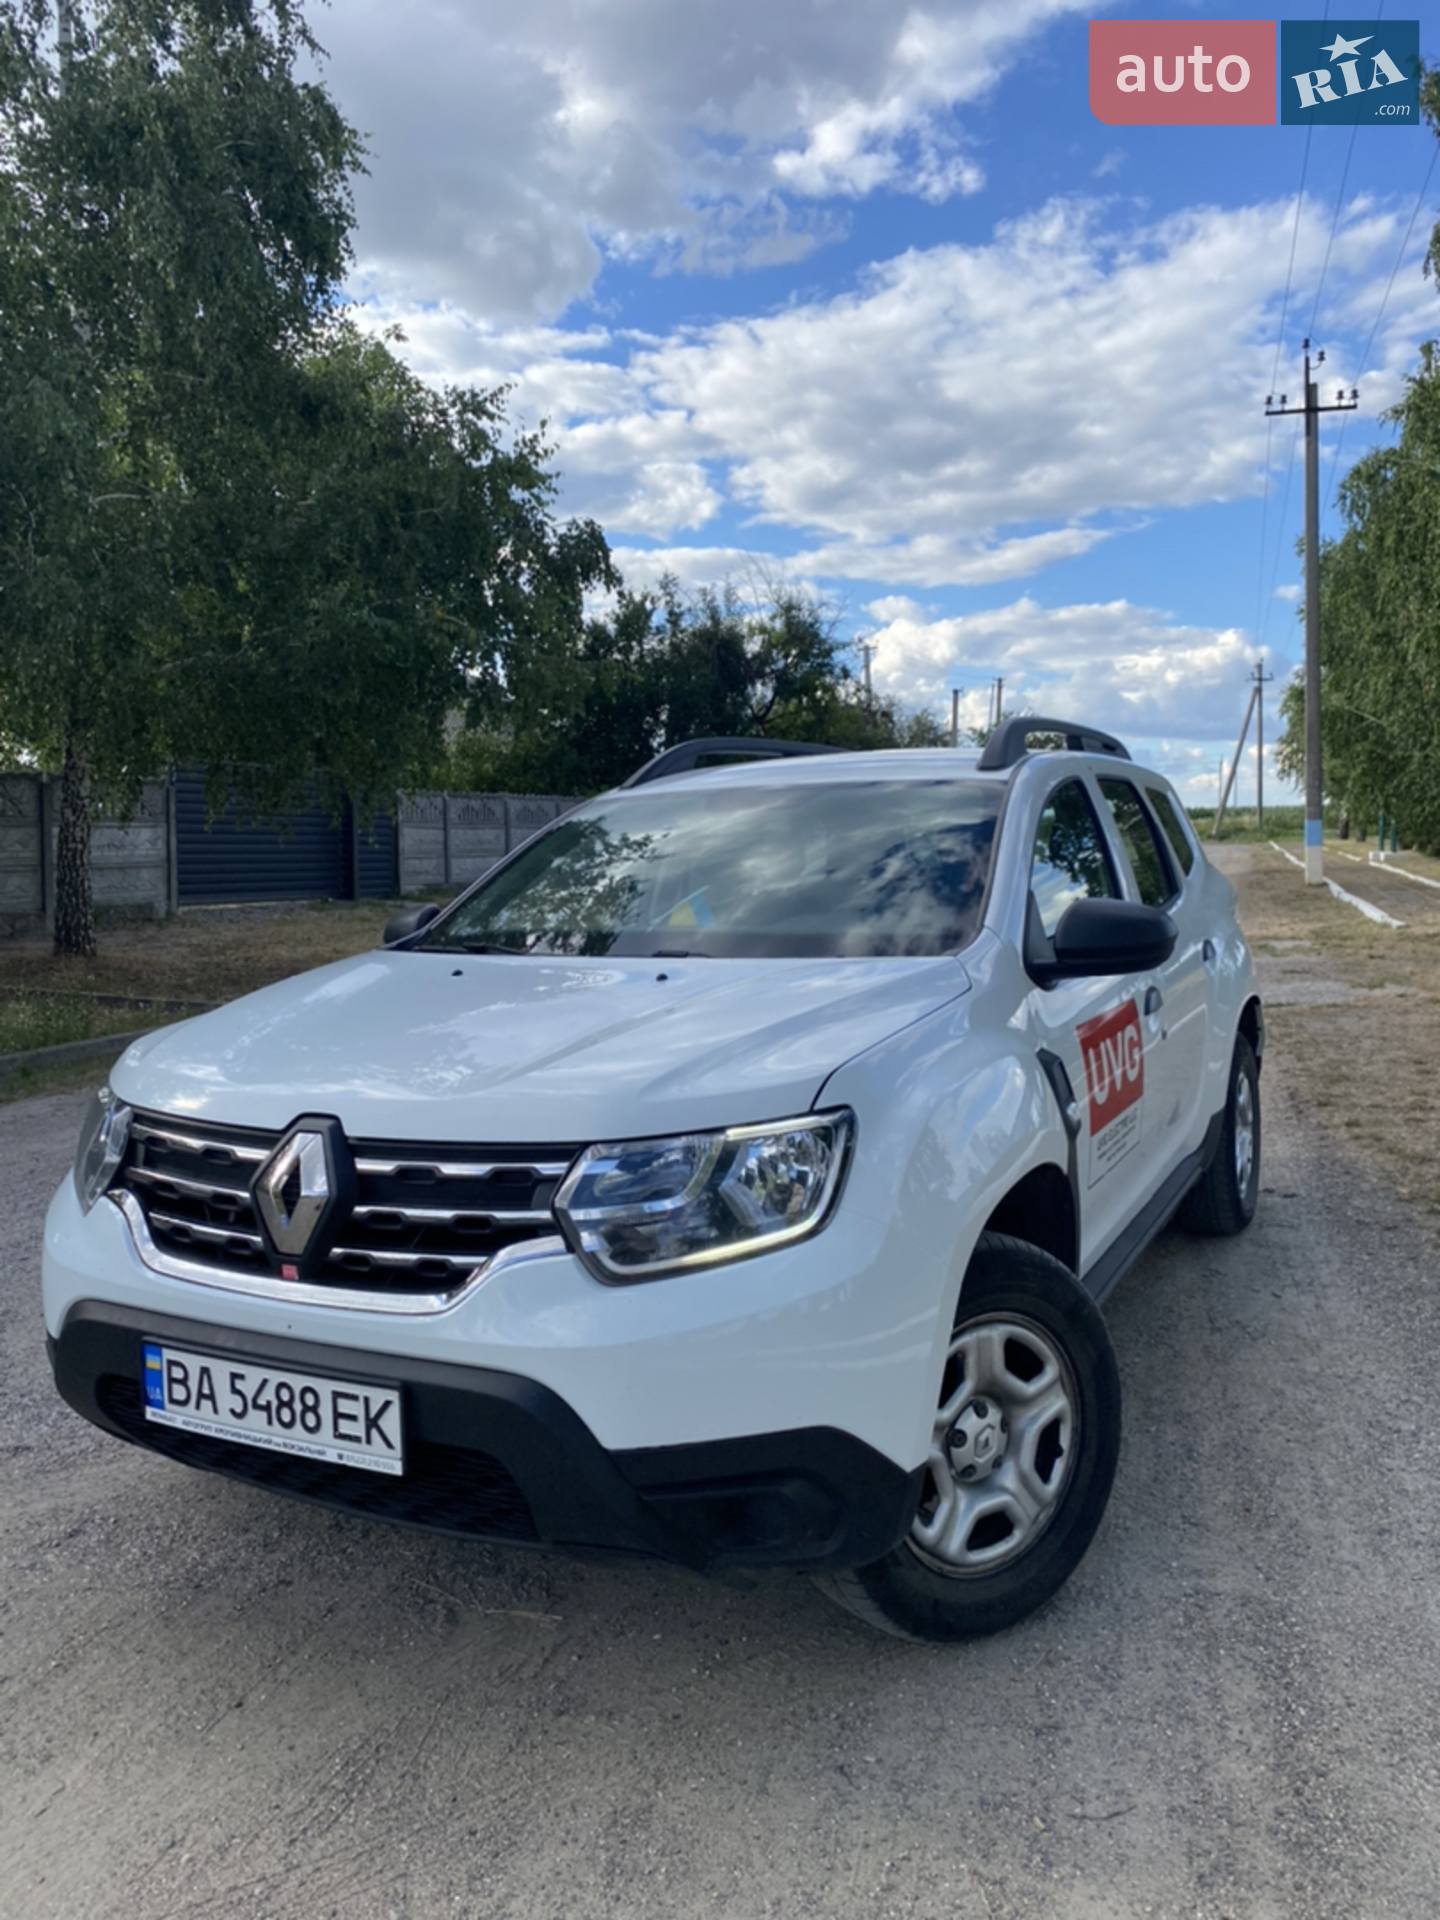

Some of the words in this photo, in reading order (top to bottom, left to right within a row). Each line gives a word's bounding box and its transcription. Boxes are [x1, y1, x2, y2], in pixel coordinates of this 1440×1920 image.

[1088, 1024, 1140, 1105] UVG
[147, 1385, 162, 1401] UA
[166, 1358, 219, 1416] BA
[229, 1371, 322, 1435] 5488
[331, 1390, 396, 1450] EK
